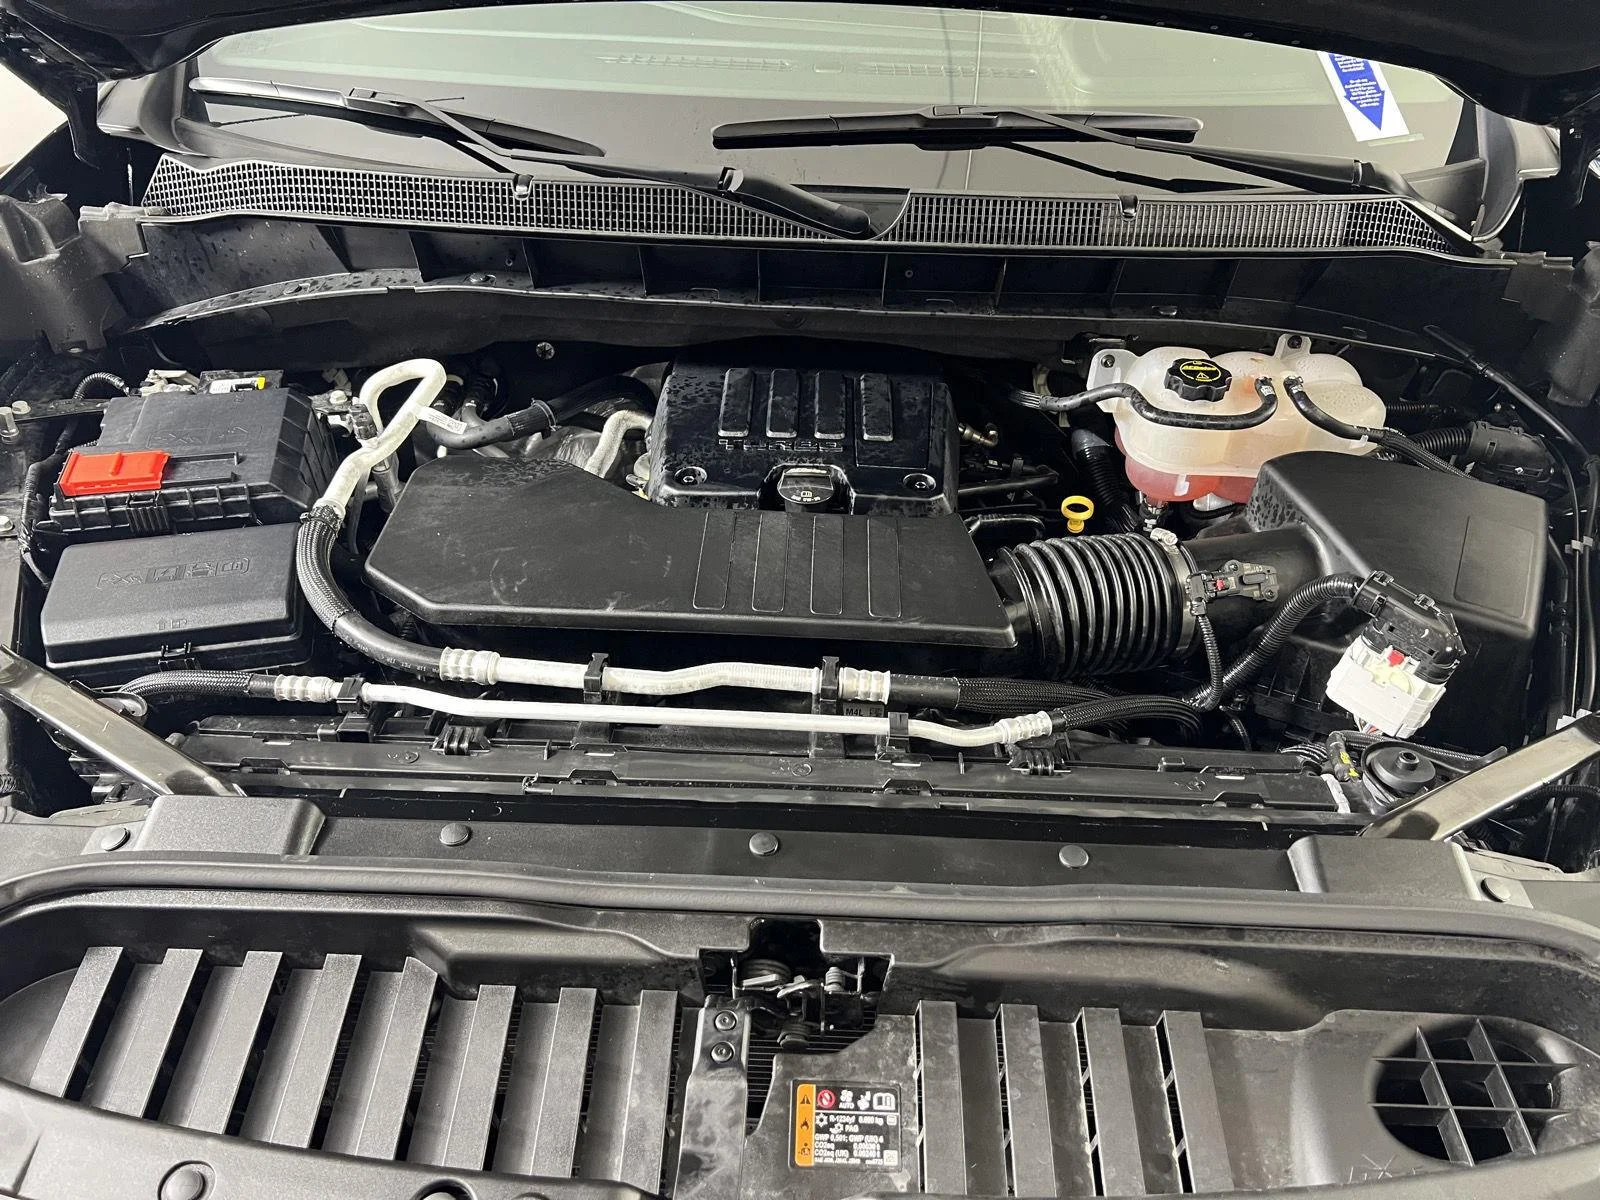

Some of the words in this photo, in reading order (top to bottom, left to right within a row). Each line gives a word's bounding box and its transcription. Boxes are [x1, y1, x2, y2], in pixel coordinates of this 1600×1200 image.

[875, 1116, 884, 1126] kg
[844, 1124, 859, 1132] PAG
[814, 1133, 830, 1141] GWP
[849, 1134, 864, 1143] GWP
